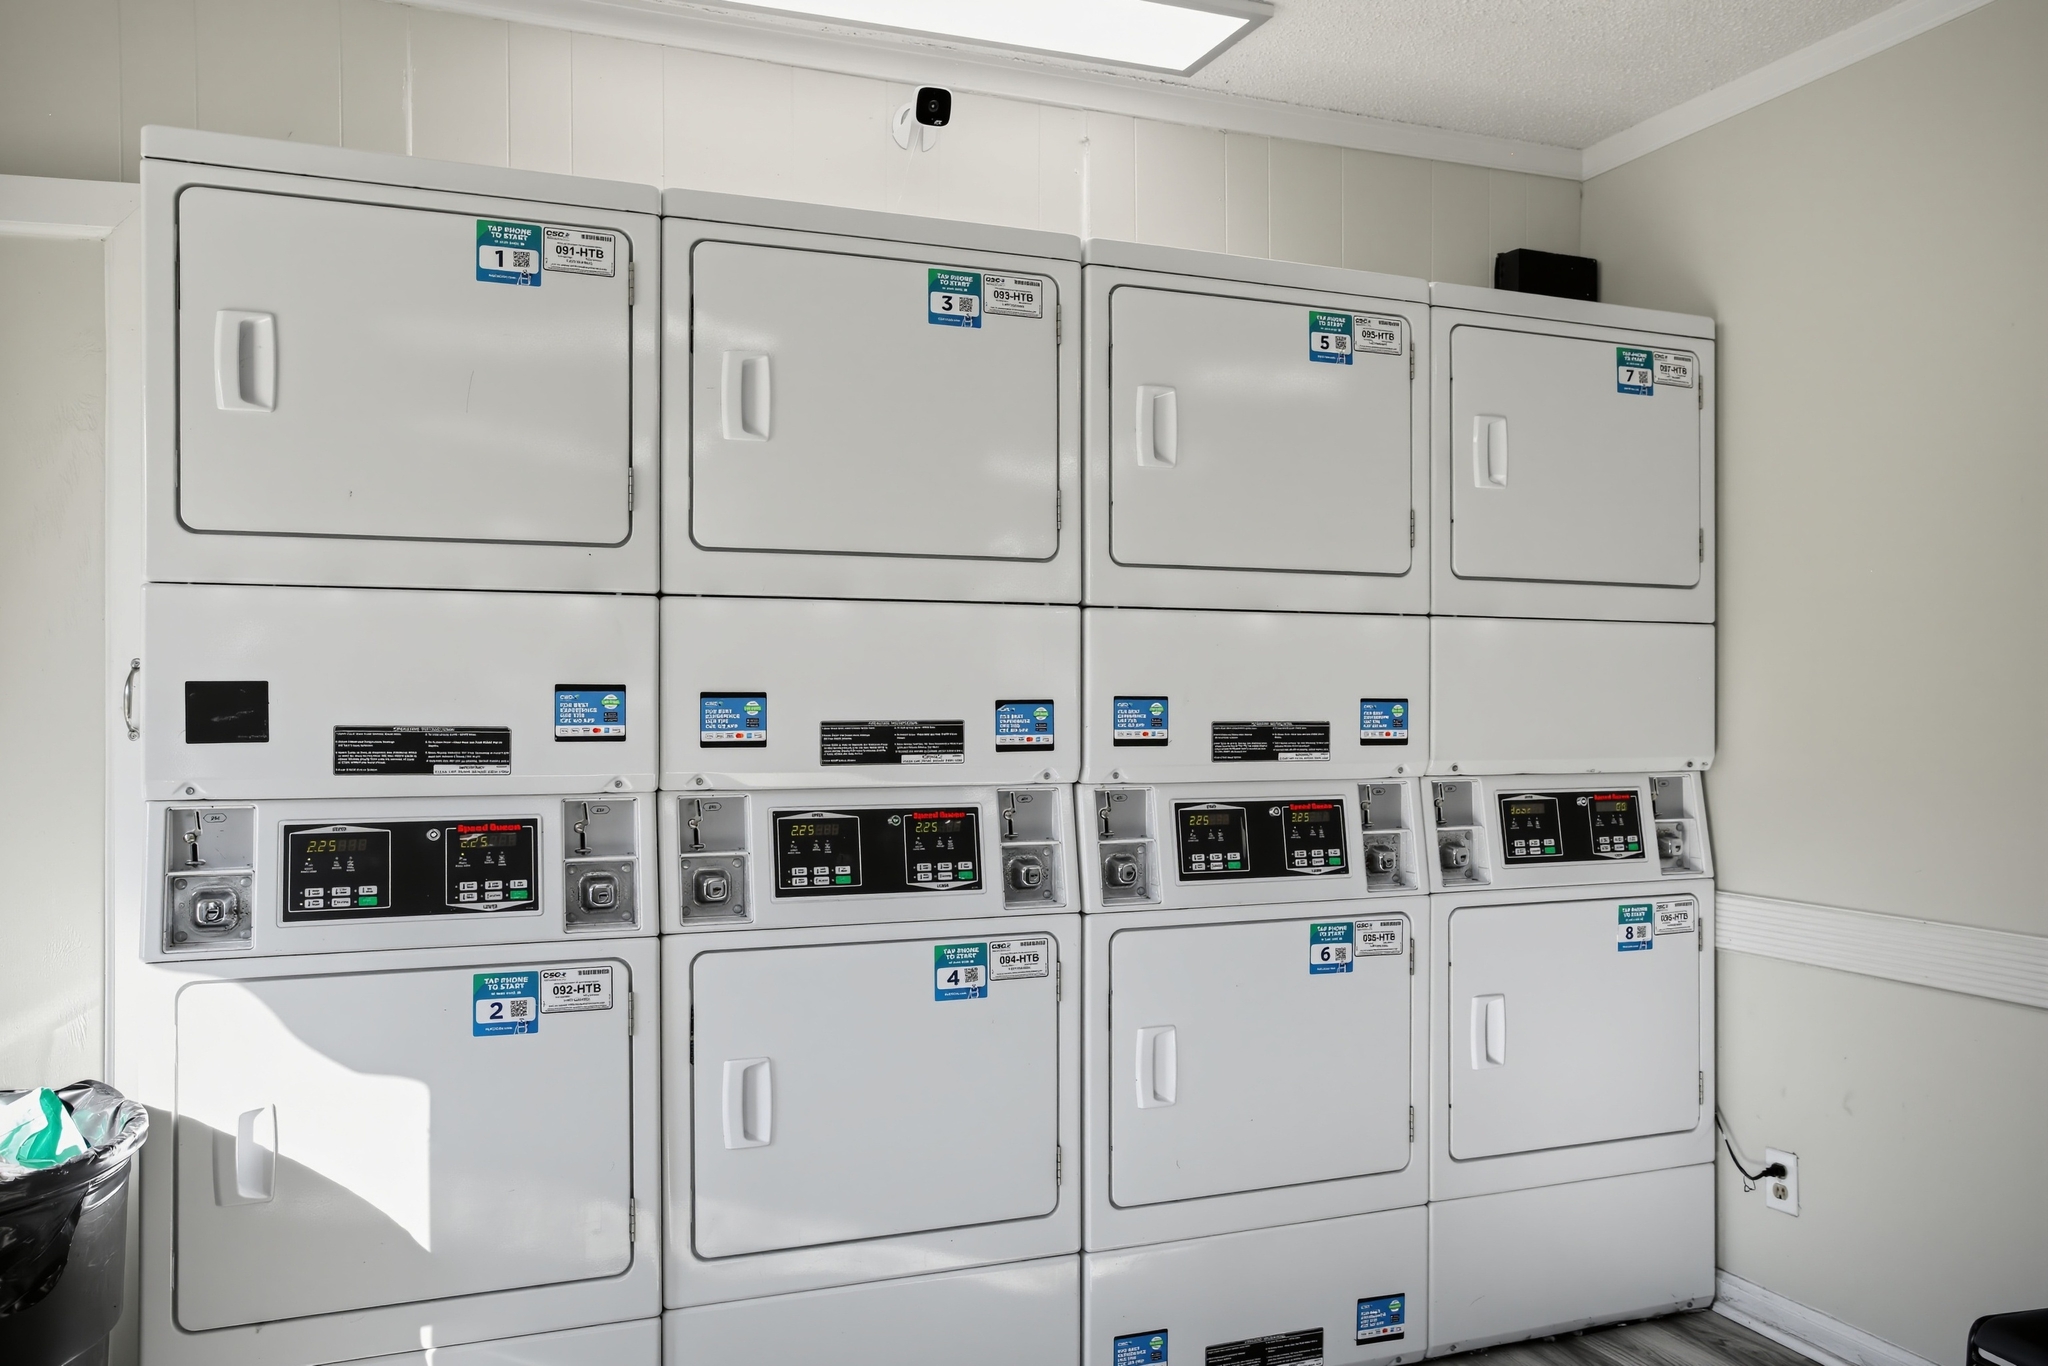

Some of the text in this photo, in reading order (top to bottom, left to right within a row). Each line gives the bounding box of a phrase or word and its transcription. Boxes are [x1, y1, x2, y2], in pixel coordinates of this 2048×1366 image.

[488, 225, 532, 236] TAP PHONE
[546, 230, 564, 238] CSC
[495, 250, 503, 267] 1
[555, 245, 604, 259] 091-HTB
[993, 290, 1034, 302] 093-HTB
[942, 295, 953, 311] 3
[1320, 335, 1330, 349] 5
[1626, 369, 1634, 382] 7
[913, 811, 938, 819] Speed
[457, 823, 521, 833] Speed Queen
[790, 824, 815, 836] 2.25
[306, 840, 336, 853] 2.25
[1625, 926, 1634, 940] 8
[1320, 946, 1331, 961] 6
[501, 976, 529, 984] PHONE
[543, 971, 561, 979] CSC
[946, 970, 960, 985] 4
[552, 983, 602, 995] 092-HTB
[489, 1002, 503, 1020] 2
